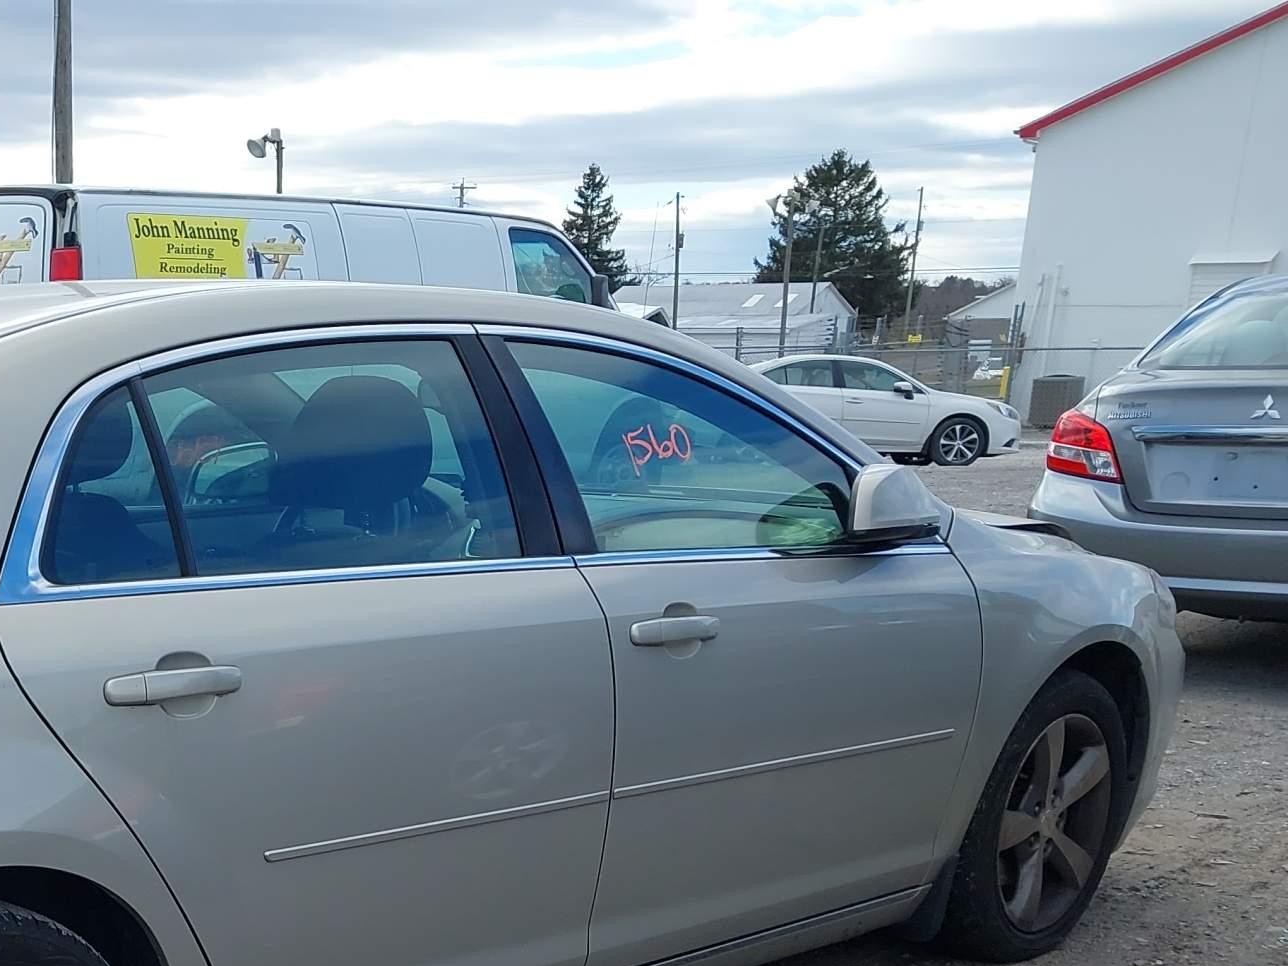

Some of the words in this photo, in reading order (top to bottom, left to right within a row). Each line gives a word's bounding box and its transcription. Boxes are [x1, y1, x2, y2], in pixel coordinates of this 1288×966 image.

[133, 217, 171, 239] John
[173, 219, 241, 247] Manning
[166, 243, 215, 258] Painting
[159, 261, 227, 277] Remodeling
[621, 423, 691, 477] 1560
